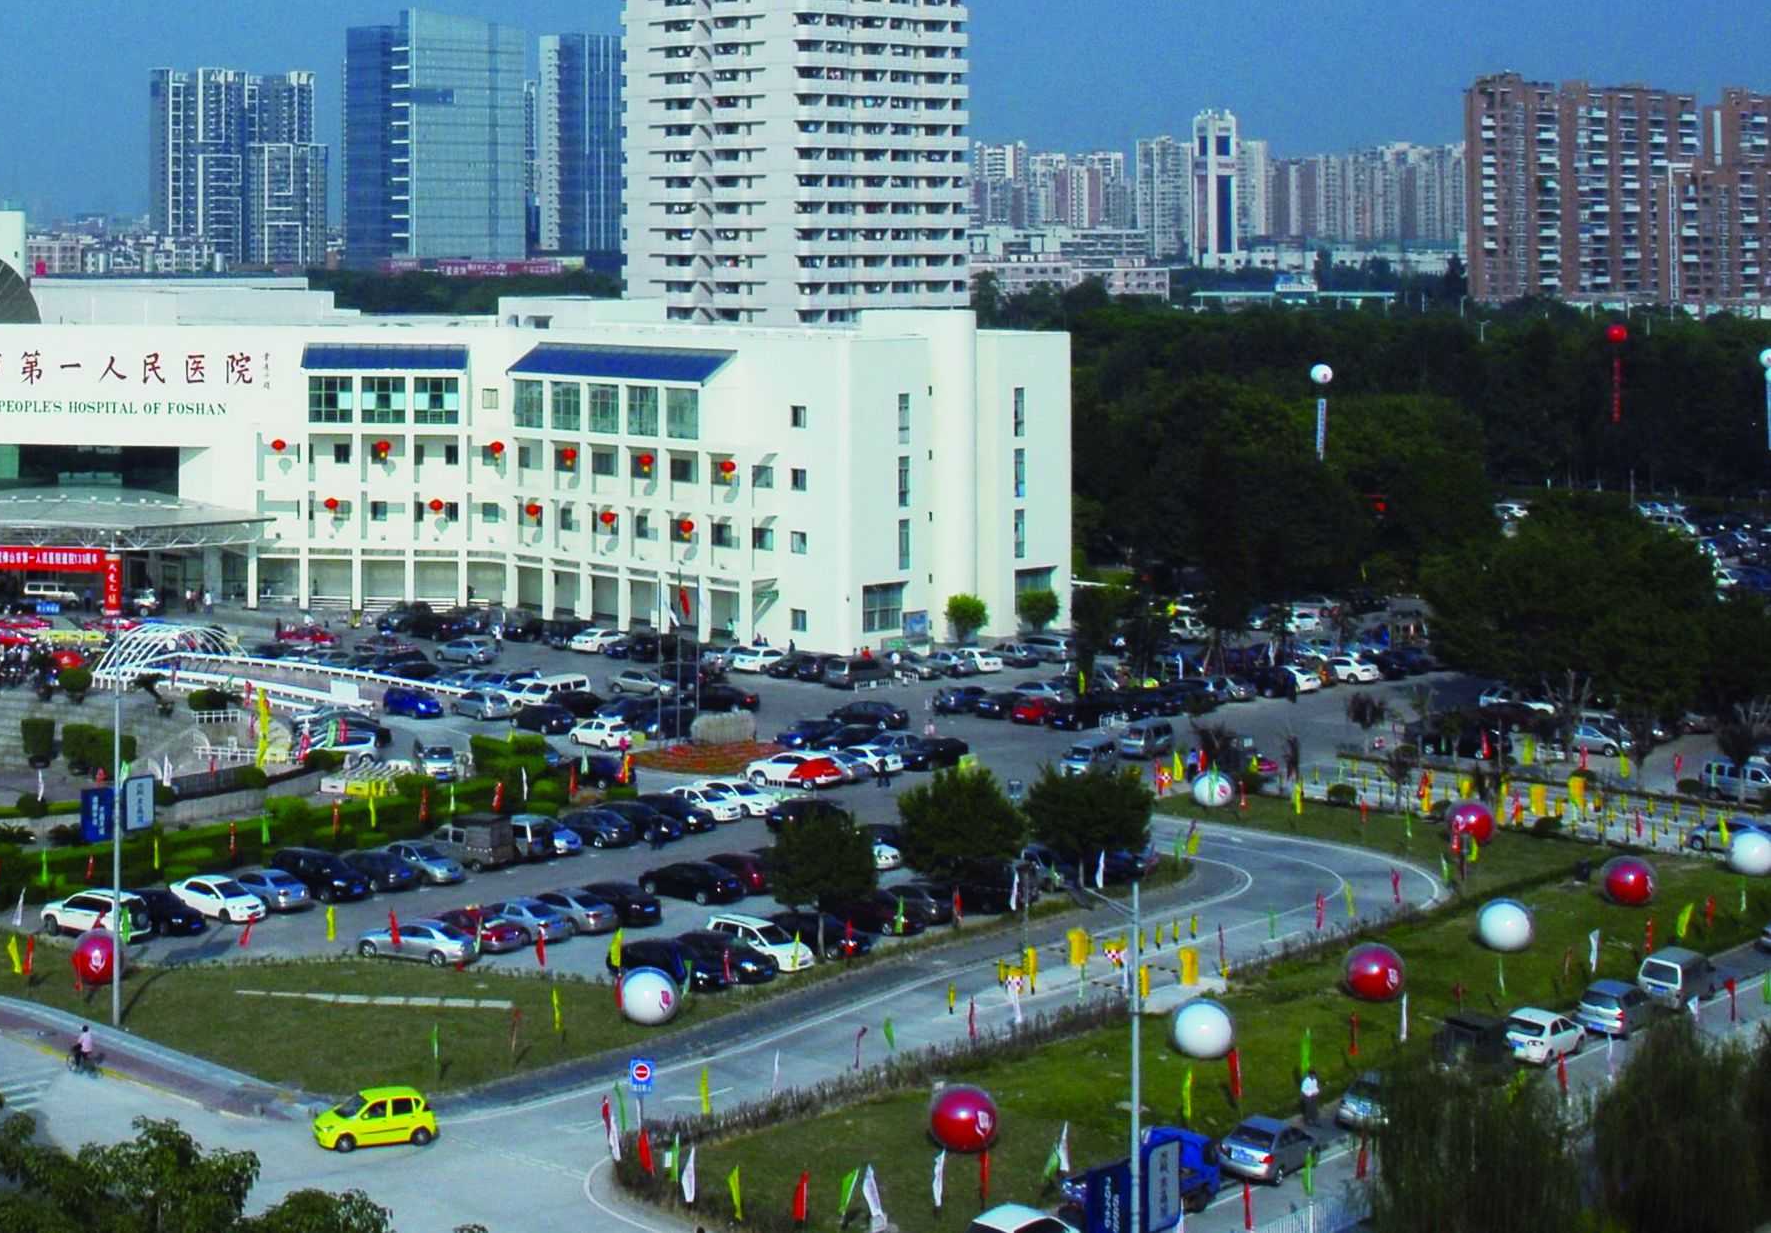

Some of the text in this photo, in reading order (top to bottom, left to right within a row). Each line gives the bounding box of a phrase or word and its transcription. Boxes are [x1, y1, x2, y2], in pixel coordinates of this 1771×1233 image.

[68, 400, 138, 415] HOSPITAL
[142, 401, 162, 415] OF
[167, 401, 227, 416] FOSHAN
